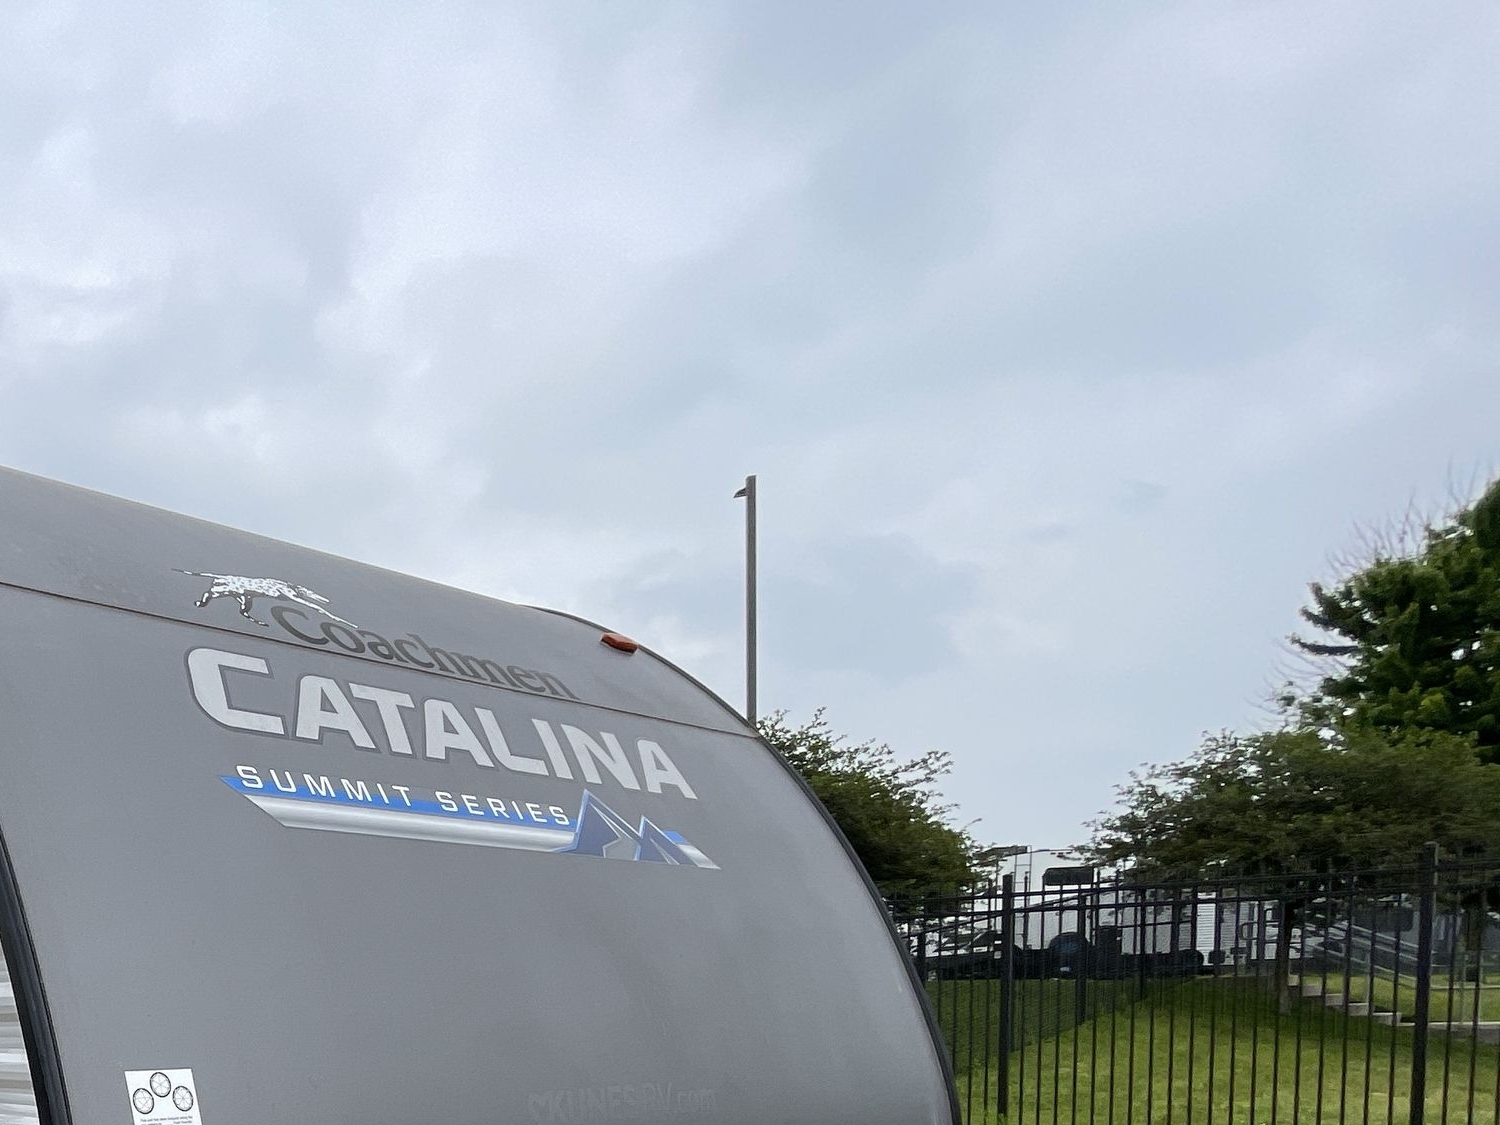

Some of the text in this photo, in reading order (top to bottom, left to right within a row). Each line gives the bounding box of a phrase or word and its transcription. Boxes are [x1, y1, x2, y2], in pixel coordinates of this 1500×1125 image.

[270, 604, 581, 700] Coachmen
[185, 646, 699, 800] CATALINA
[235, 764, 571, 826] SUMMIT SERIES
